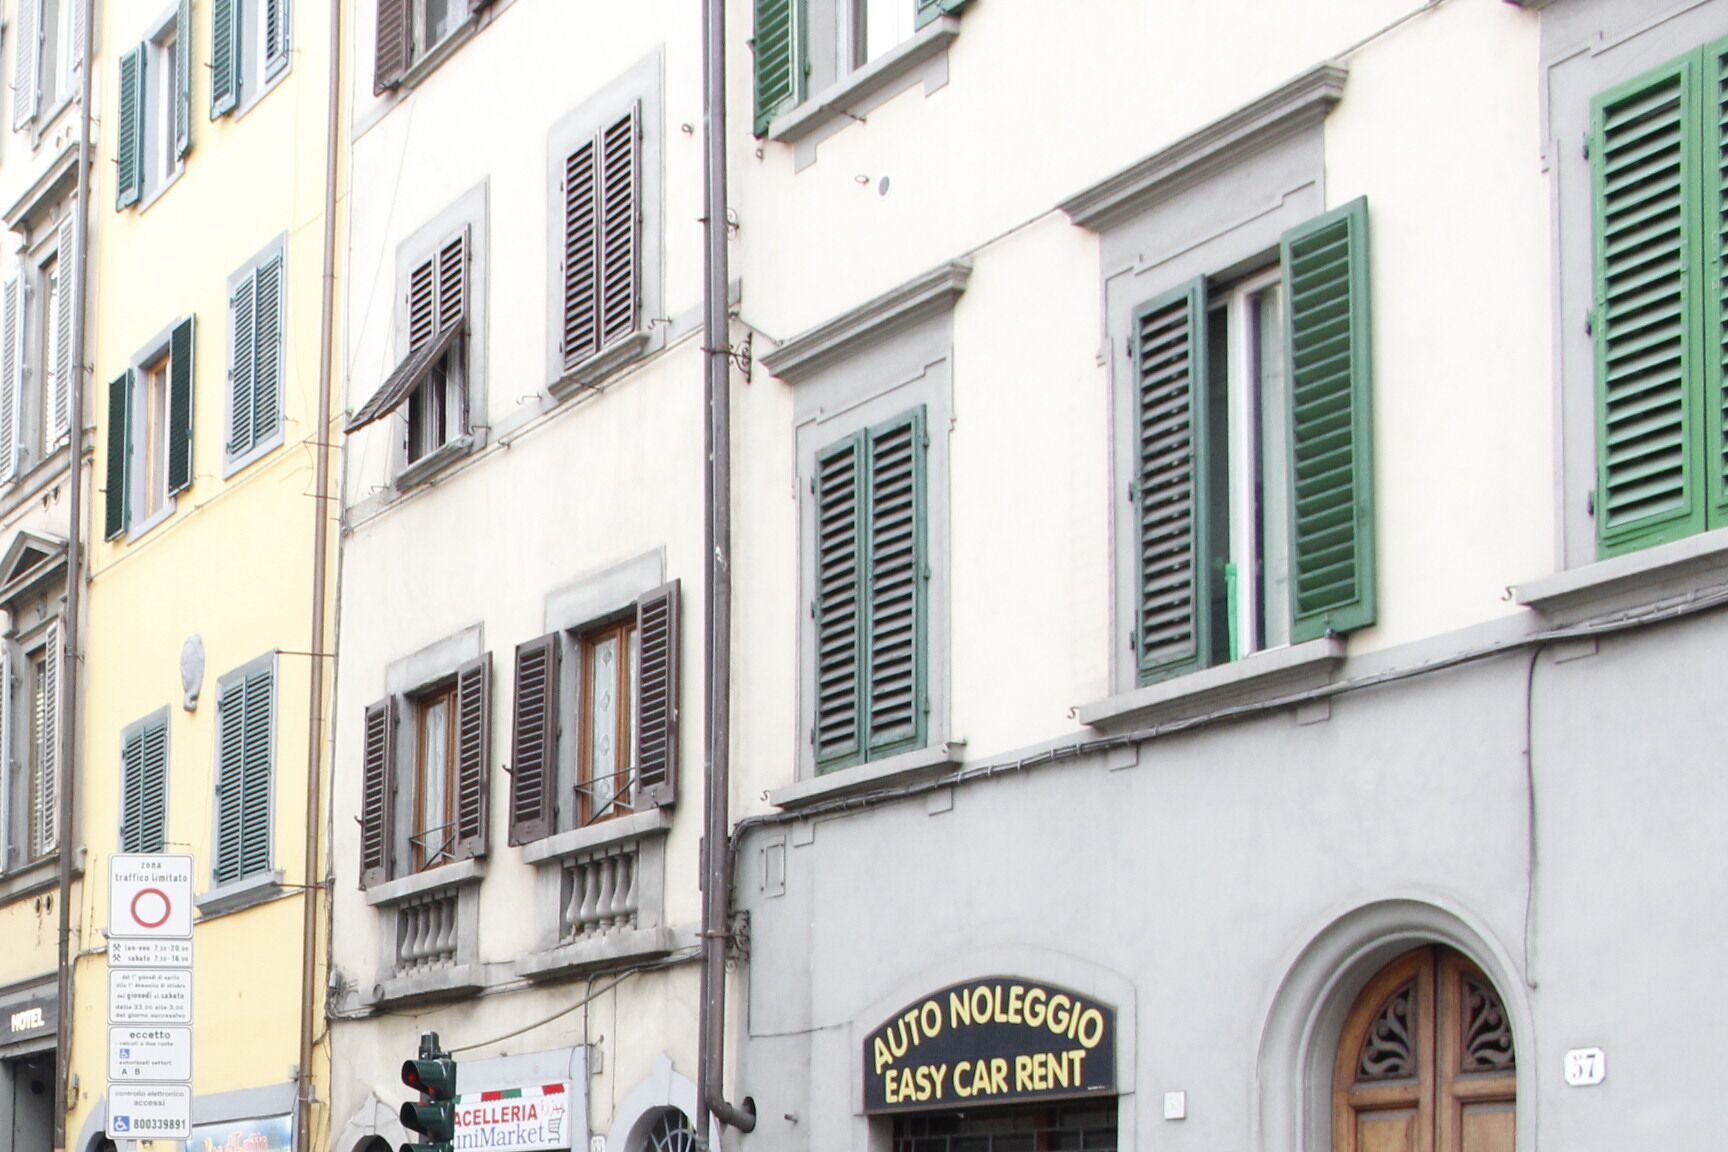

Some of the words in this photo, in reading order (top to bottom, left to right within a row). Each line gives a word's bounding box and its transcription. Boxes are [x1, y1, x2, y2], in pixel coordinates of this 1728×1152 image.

[115, 873, 149, 882] traffico
[151, 873, 188, 882] limitato
[129, 1031, 171, 1039] eccetto
[873, 1000, 943, 1075] AUTO
[949, 984, 1104, 1049] NOLEGGIO
[121, 1068, 128, 1076] A
[134, 1068, 140, 1076] B
[884, 1063, 947, 1104] EASY
[953, 1057, 1008, 1098] CAR
[1015, 1050, 1086, 1093] RENT
[1572, 1053, 1596, 1080] 57
[133, 1118, 186, 1130] 800339891
[454, 1104, 538, 1127] ACELLERIA
[456, 1123, 546, 1150] iniMarket
